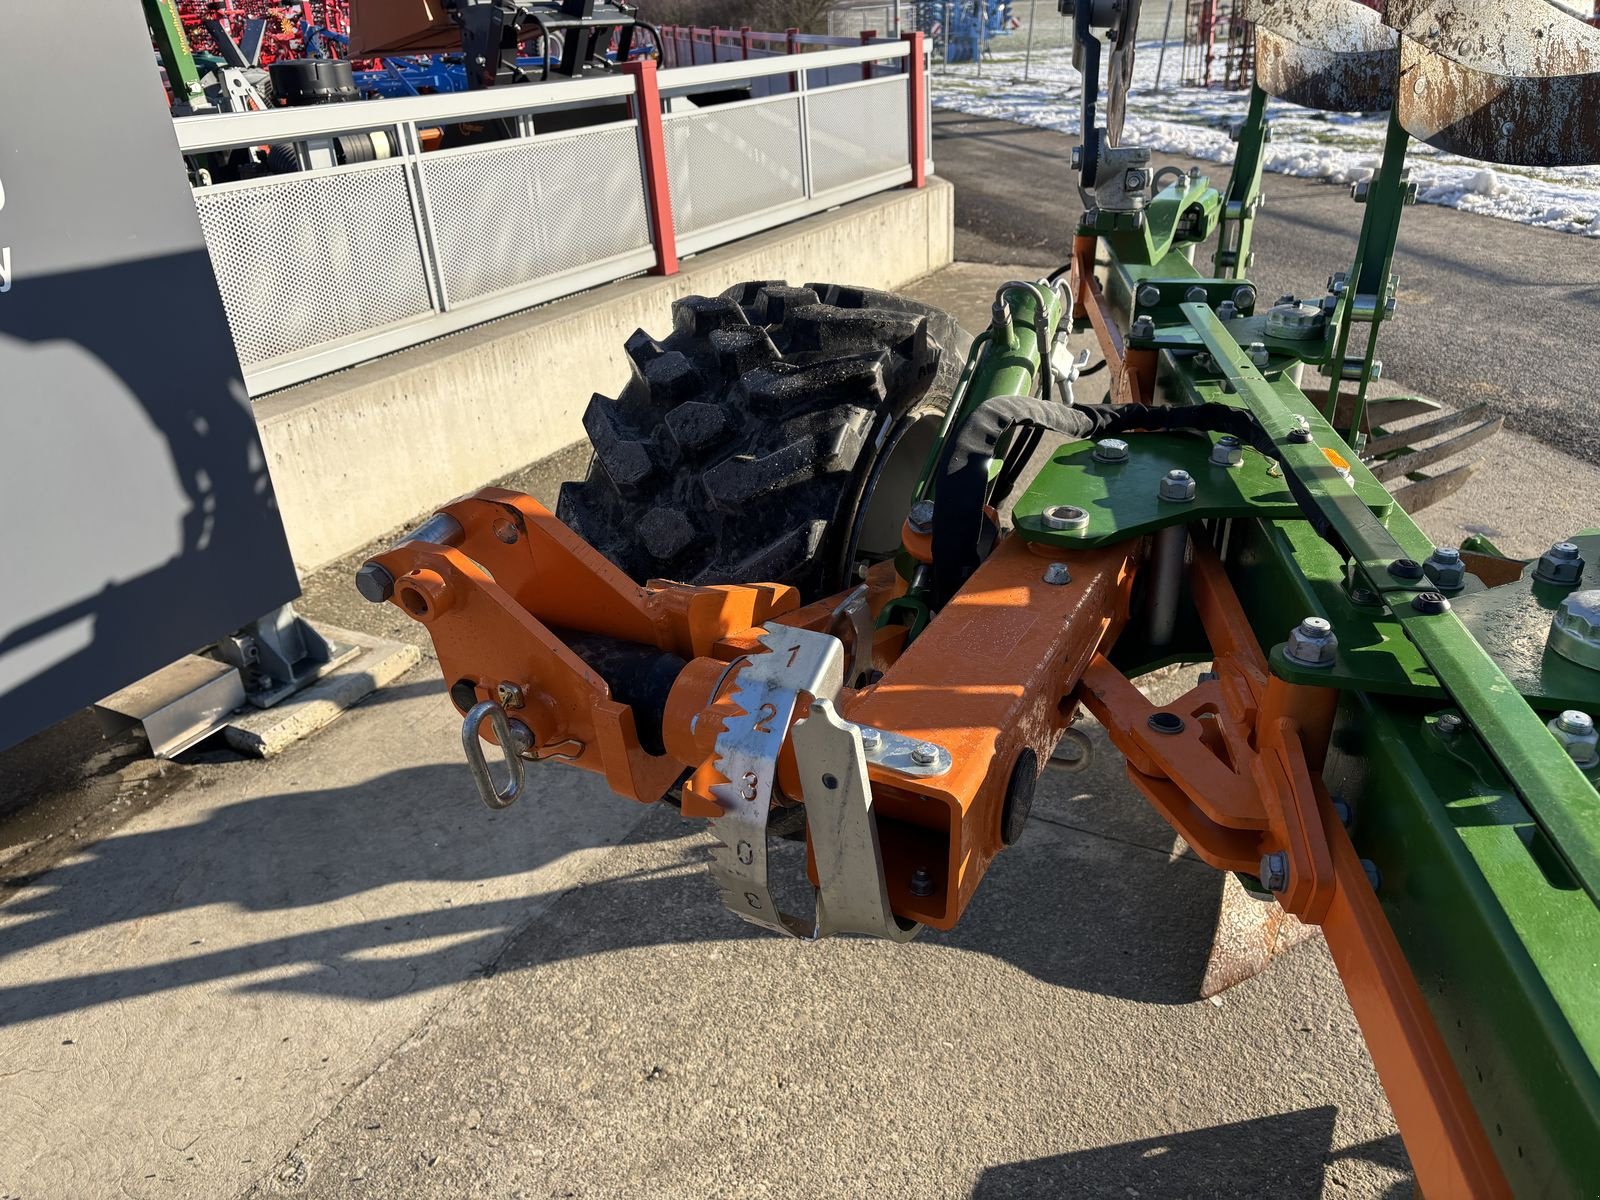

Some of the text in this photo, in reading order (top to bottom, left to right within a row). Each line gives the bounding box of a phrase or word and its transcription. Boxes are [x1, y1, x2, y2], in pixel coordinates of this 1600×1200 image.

[786, 644, 801, 668] 1
[753, 704, 778, 733] 2
[738, 772, 759, 801] 3
